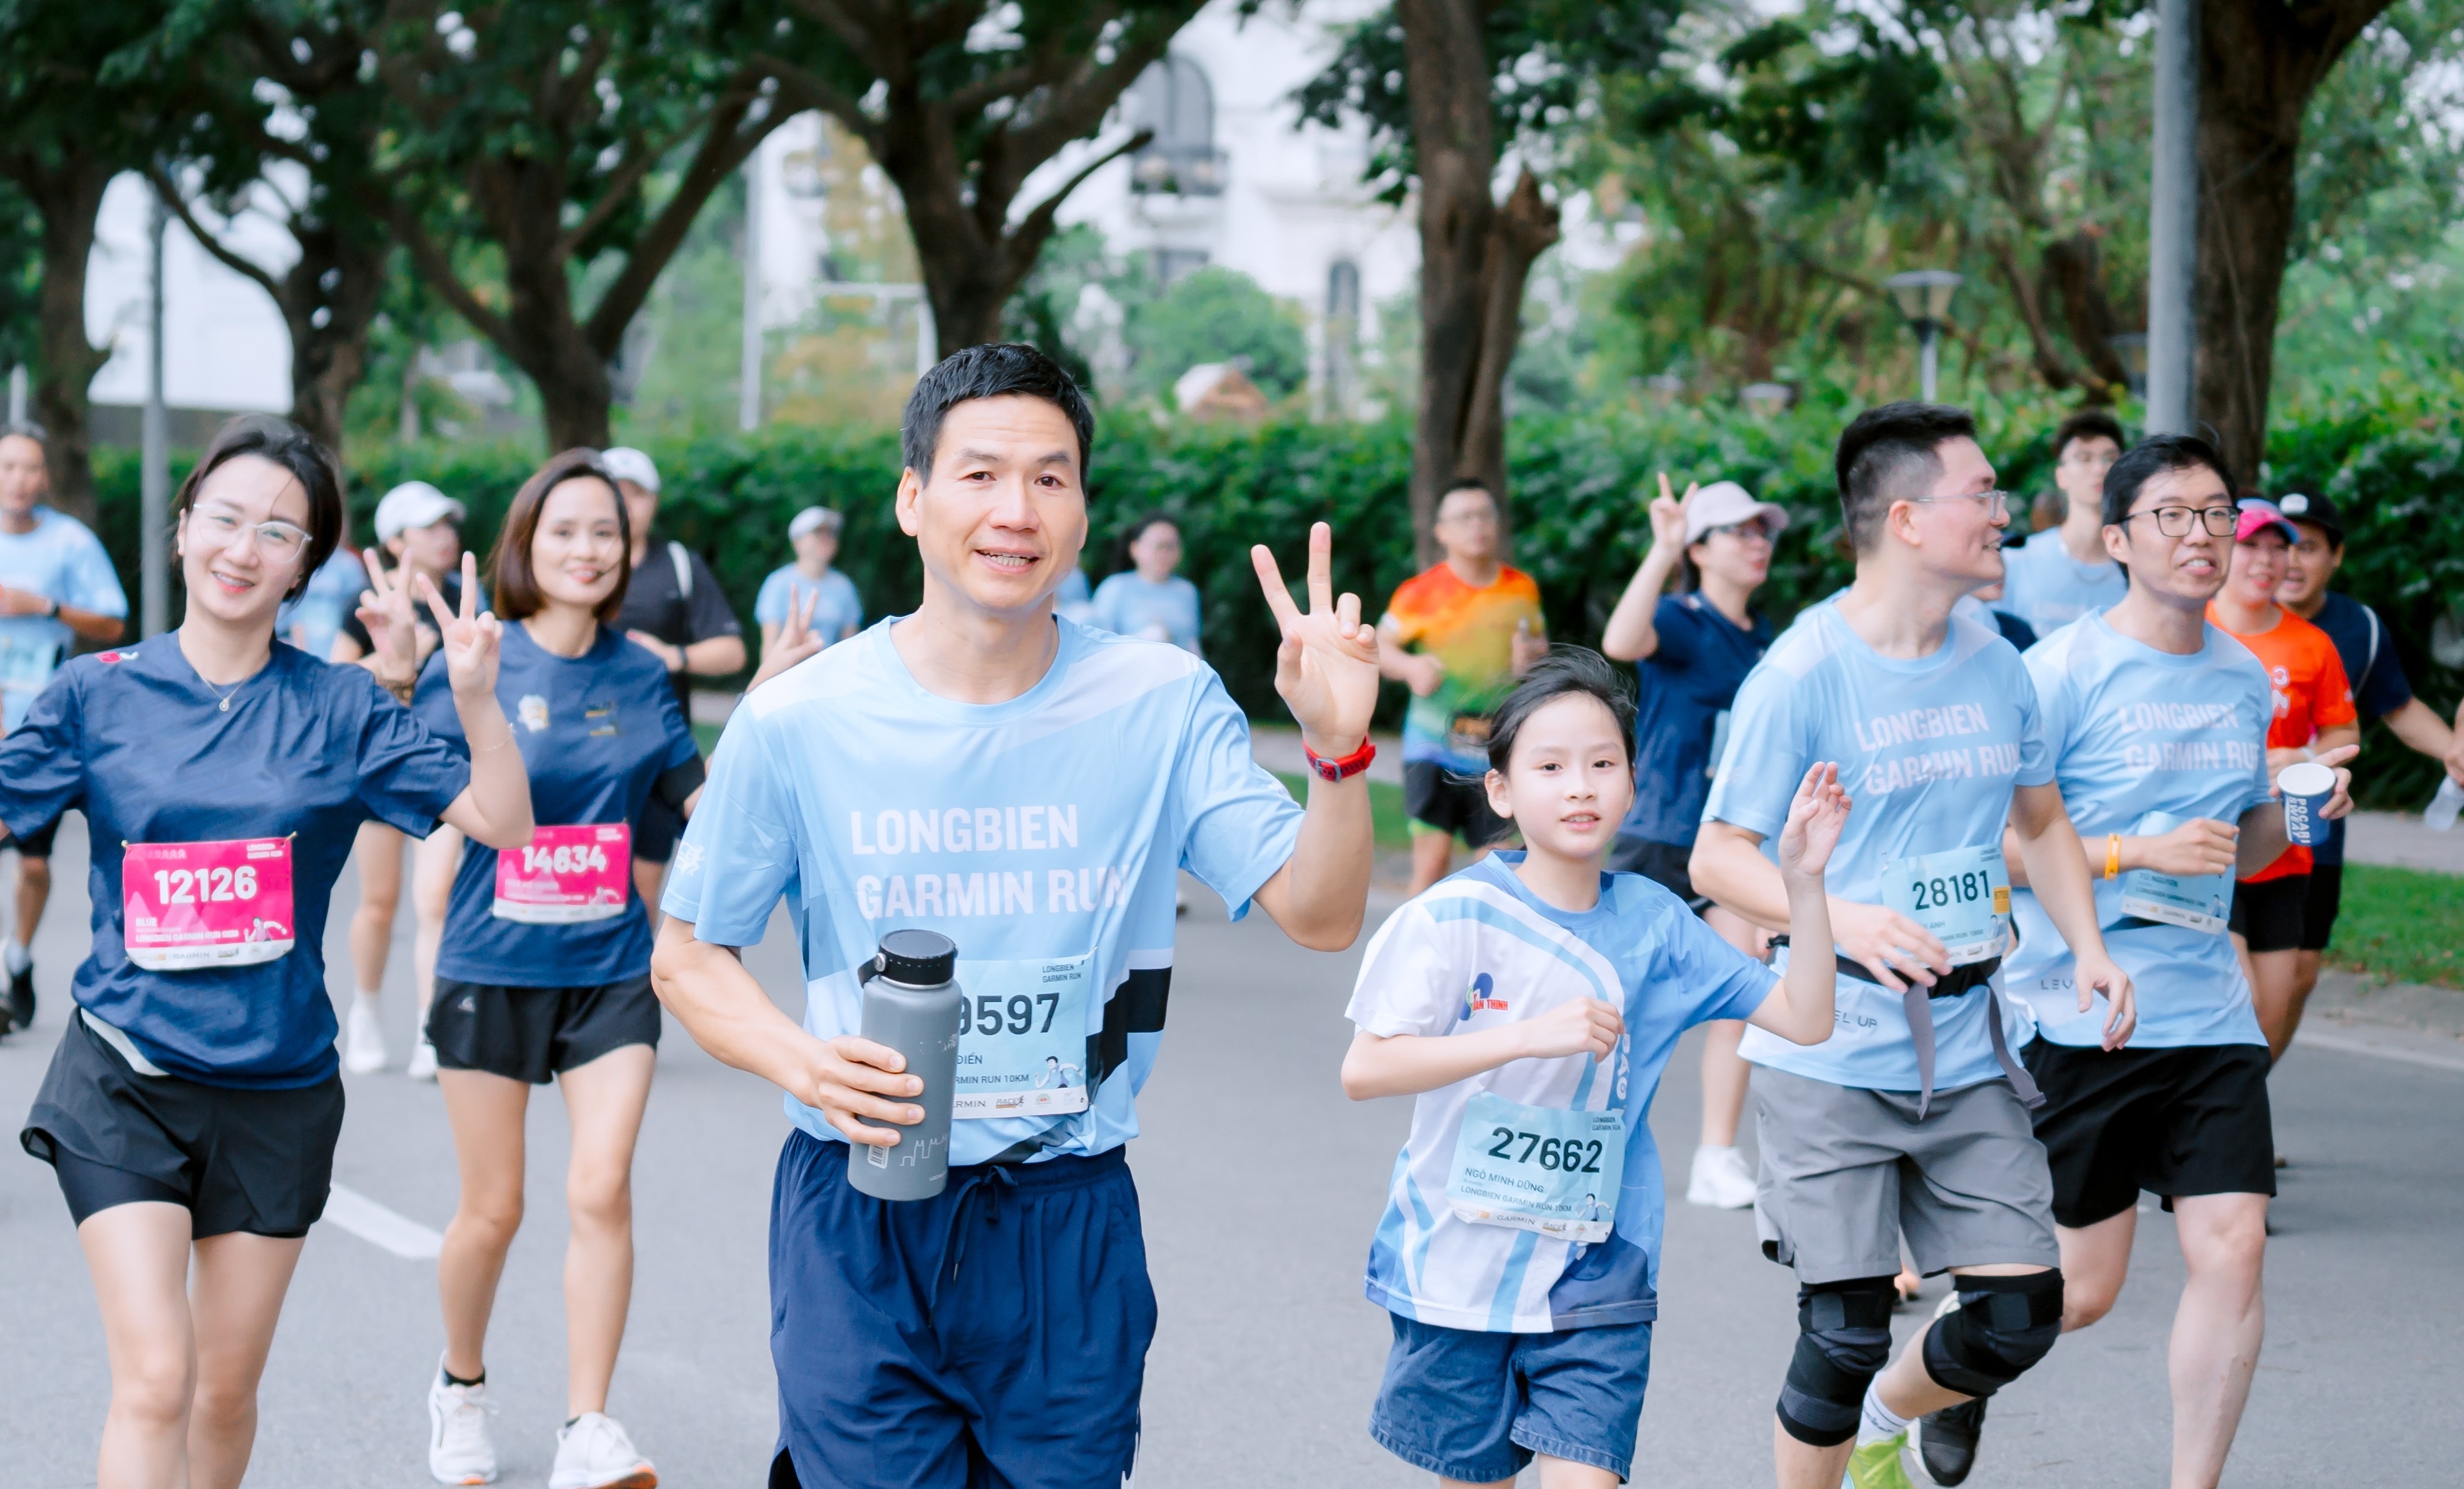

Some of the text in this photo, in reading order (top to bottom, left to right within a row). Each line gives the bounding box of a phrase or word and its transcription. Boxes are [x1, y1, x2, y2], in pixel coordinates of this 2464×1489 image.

[1854, 702, 1989, 752] LONGBIEN
[2117, 702, 2239, 734] LONGBIEN
[1865, 748, 1973, 796] GARMIN
[2125, 740, 2220, 772] GARMIN
[850, 804, 1079, 855] LONGBIEN
[2296, 798, 2311, 844] POCARI
[154, 866, 257, 904] 12126
[856, 864, 1131, 920] GARMIN RUN
[1912, 869, 1989, 911] 28181
[1042, 964, 1074, 973] LONGBIEN
[1042, 974, 1068, 983] GARMIN
[1857, 1016, 1877, 1028] UP
[981, 1075, 1001, 1083] RUN
[1004, 1074, 1029, 1083] 10KM
[953, 1100, 986, 1108] RMIN
[1487, 1127, 1603, 1174] 27662
[1465, 1168, 1486, 1180] NGÔ
[1488, 1173, 1514, 1187] MINH
[1460, 1185, 1501, 1200] LONGBIEN
[1502, 1195, 1534, 1208] GARMIN
[1536, 1202, 1553, 1211] RUN
[1497, 1214, 1536, 1225] GARMIN
